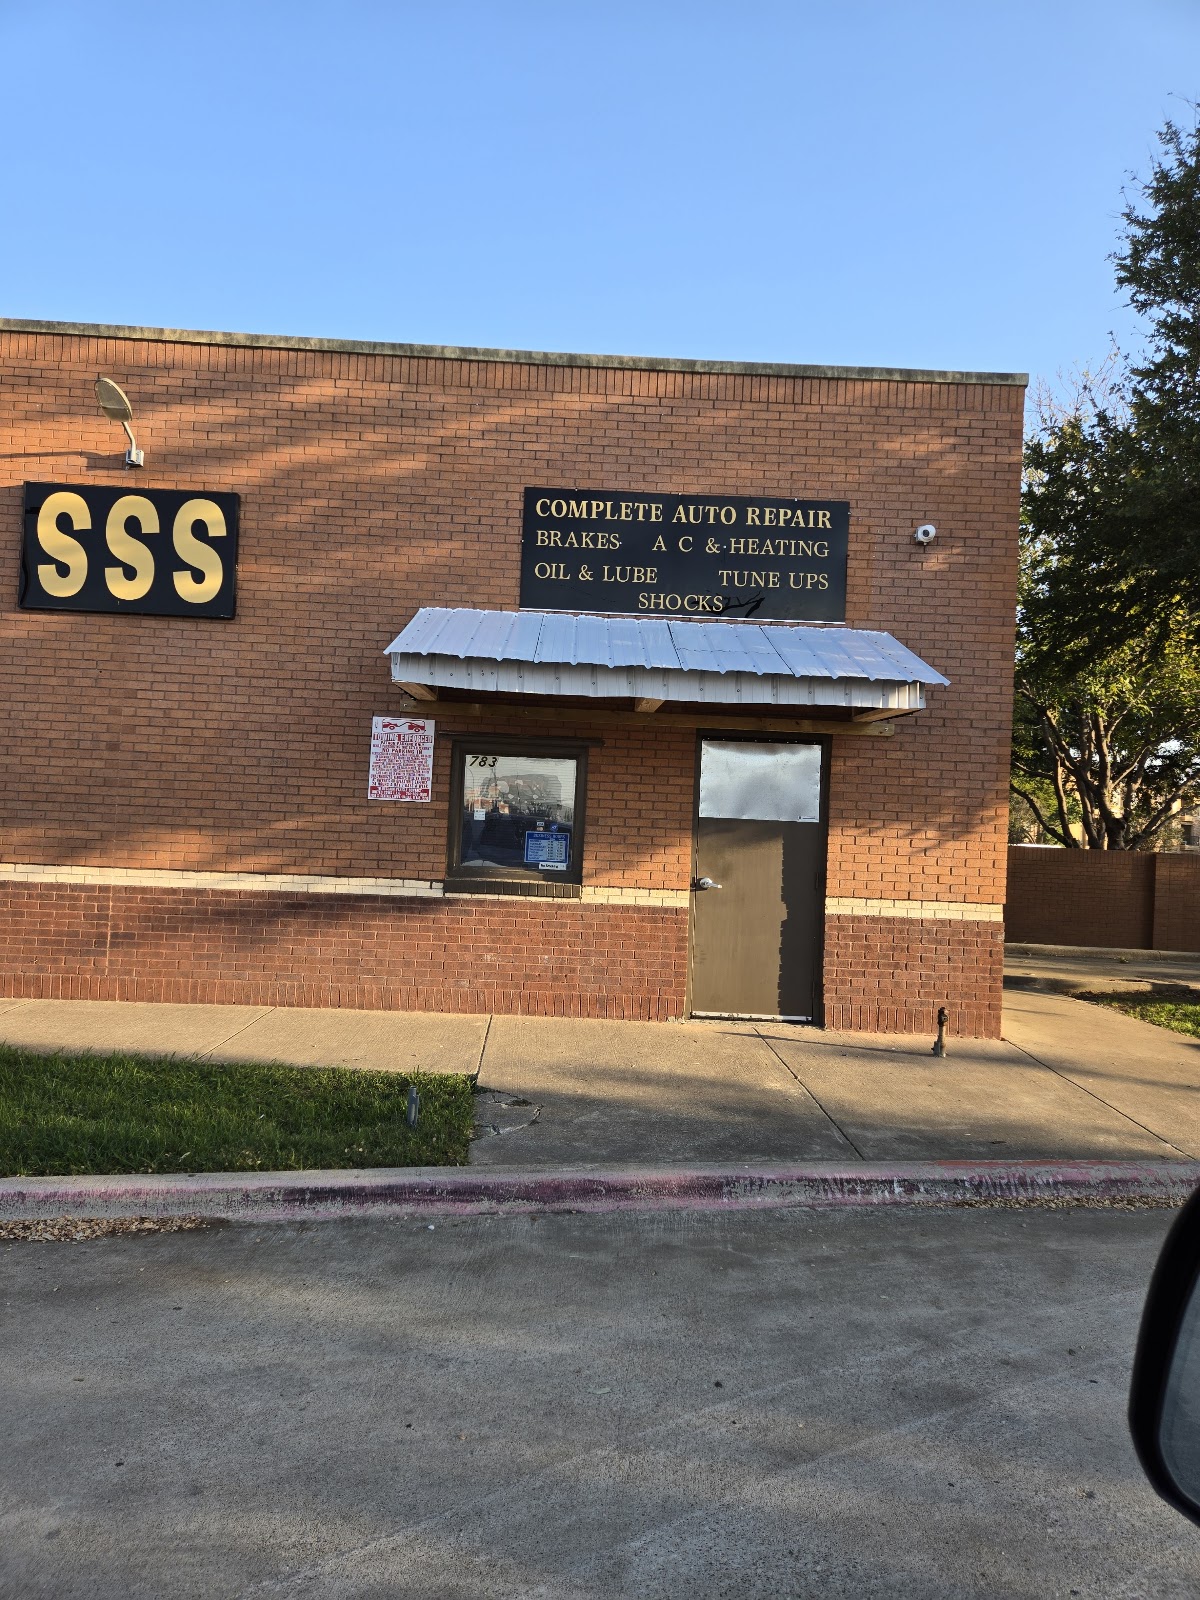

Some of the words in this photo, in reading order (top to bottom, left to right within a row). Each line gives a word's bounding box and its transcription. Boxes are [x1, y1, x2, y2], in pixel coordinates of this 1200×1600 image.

[535, 498, 663, 522] COMPLETE
[672, 504, 737, 525] AUTO
[746, 506, 832, 529] REPAIR
[37, 491, 227, 604] SSS
[535, 530, 619, 549] BRAKES
[705, 537, 721, 553] &
[729, 538, 829, 557] HEATING
[534, 562, 571, 580] OIL
[578, 564, 594, 581] &
[602, 566, 658, 583] LUBE
[719, 570, 780, 588] TUNE
[789, 572, 829, 590] UPS
[638, 592, 723, 612] SHOCKS
[469, 755, 498, 768] 783
